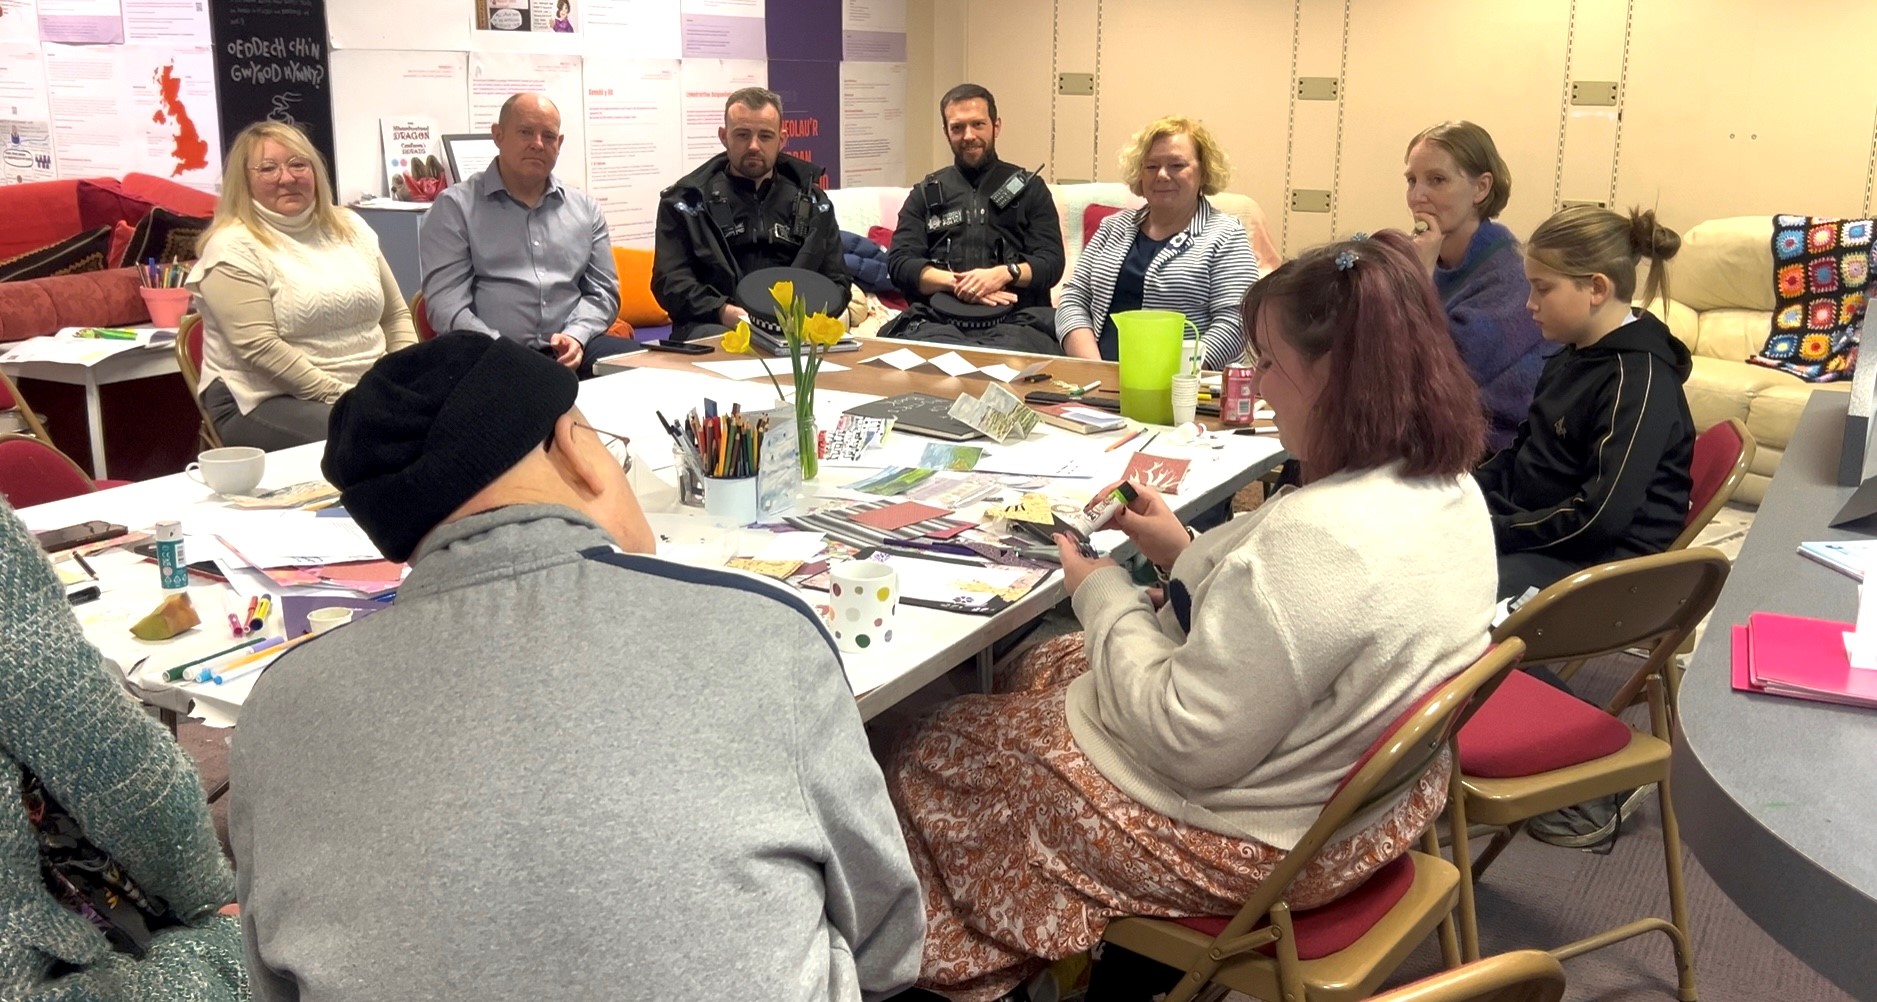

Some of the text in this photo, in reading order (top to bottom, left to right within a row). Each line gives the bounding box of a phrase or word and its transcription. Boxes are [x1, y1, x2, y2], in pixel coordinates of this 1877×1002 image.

[231, 60, 324, 89] GWYBOD HYNNY?
[393, 132, 430, 140] DRAGON
